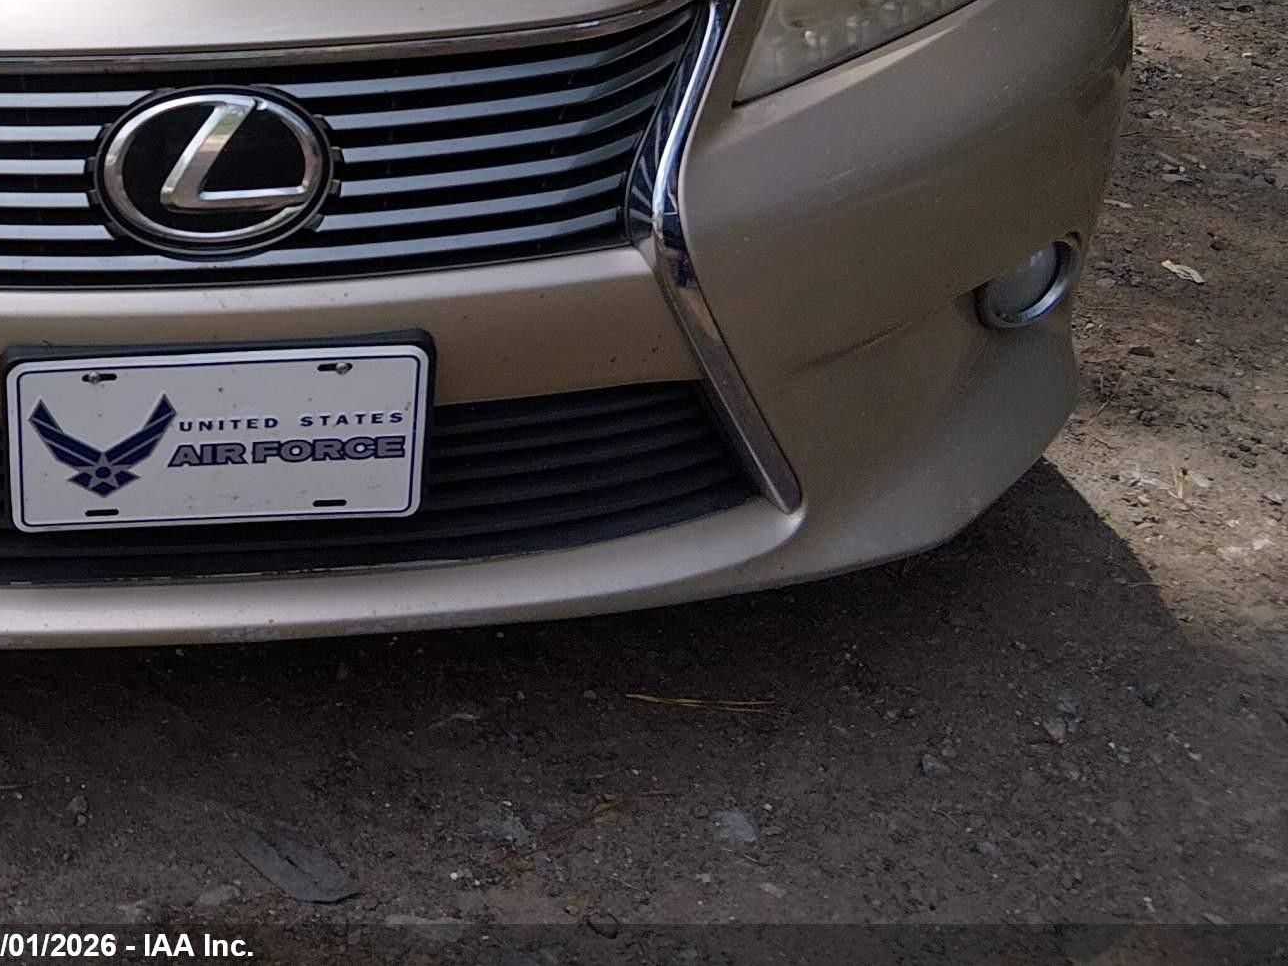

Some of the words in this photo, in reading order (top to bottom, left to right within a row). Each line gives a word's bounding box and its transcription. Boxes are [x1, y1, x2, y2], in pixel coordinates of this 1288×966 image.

[179, 417, 279, 432] UNITED
[300, 412, 403, 427] STATES
[168, 442, 248, 467] AIR
[251, 435, 406, 464] FORCE
